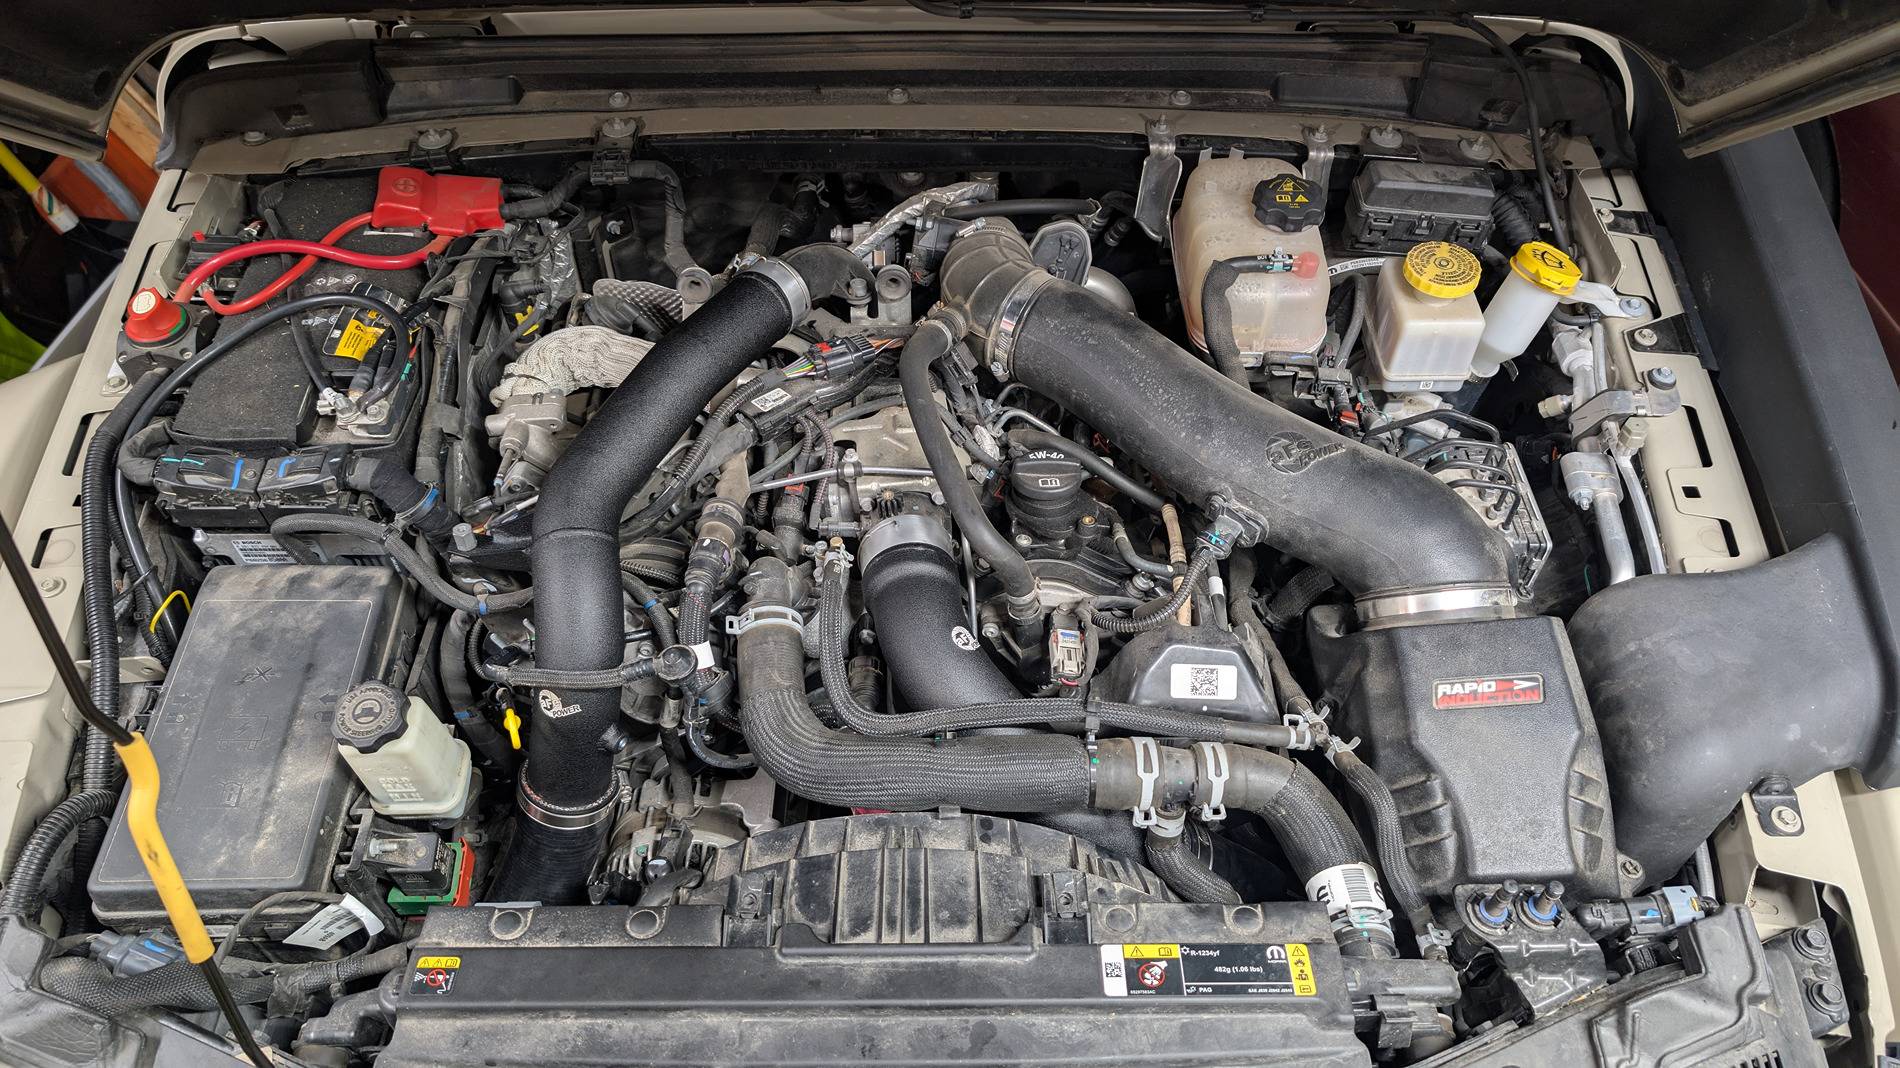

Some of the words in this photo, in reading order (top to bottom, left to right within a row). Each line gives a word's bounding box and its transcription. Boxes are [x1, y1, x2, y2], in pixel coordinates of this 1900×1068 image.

[1438, 680, 1496, 698] RAPID
[1190, 949, 1220, 958] R-1234yf
[1214, 966, 1231, 974] 482g
